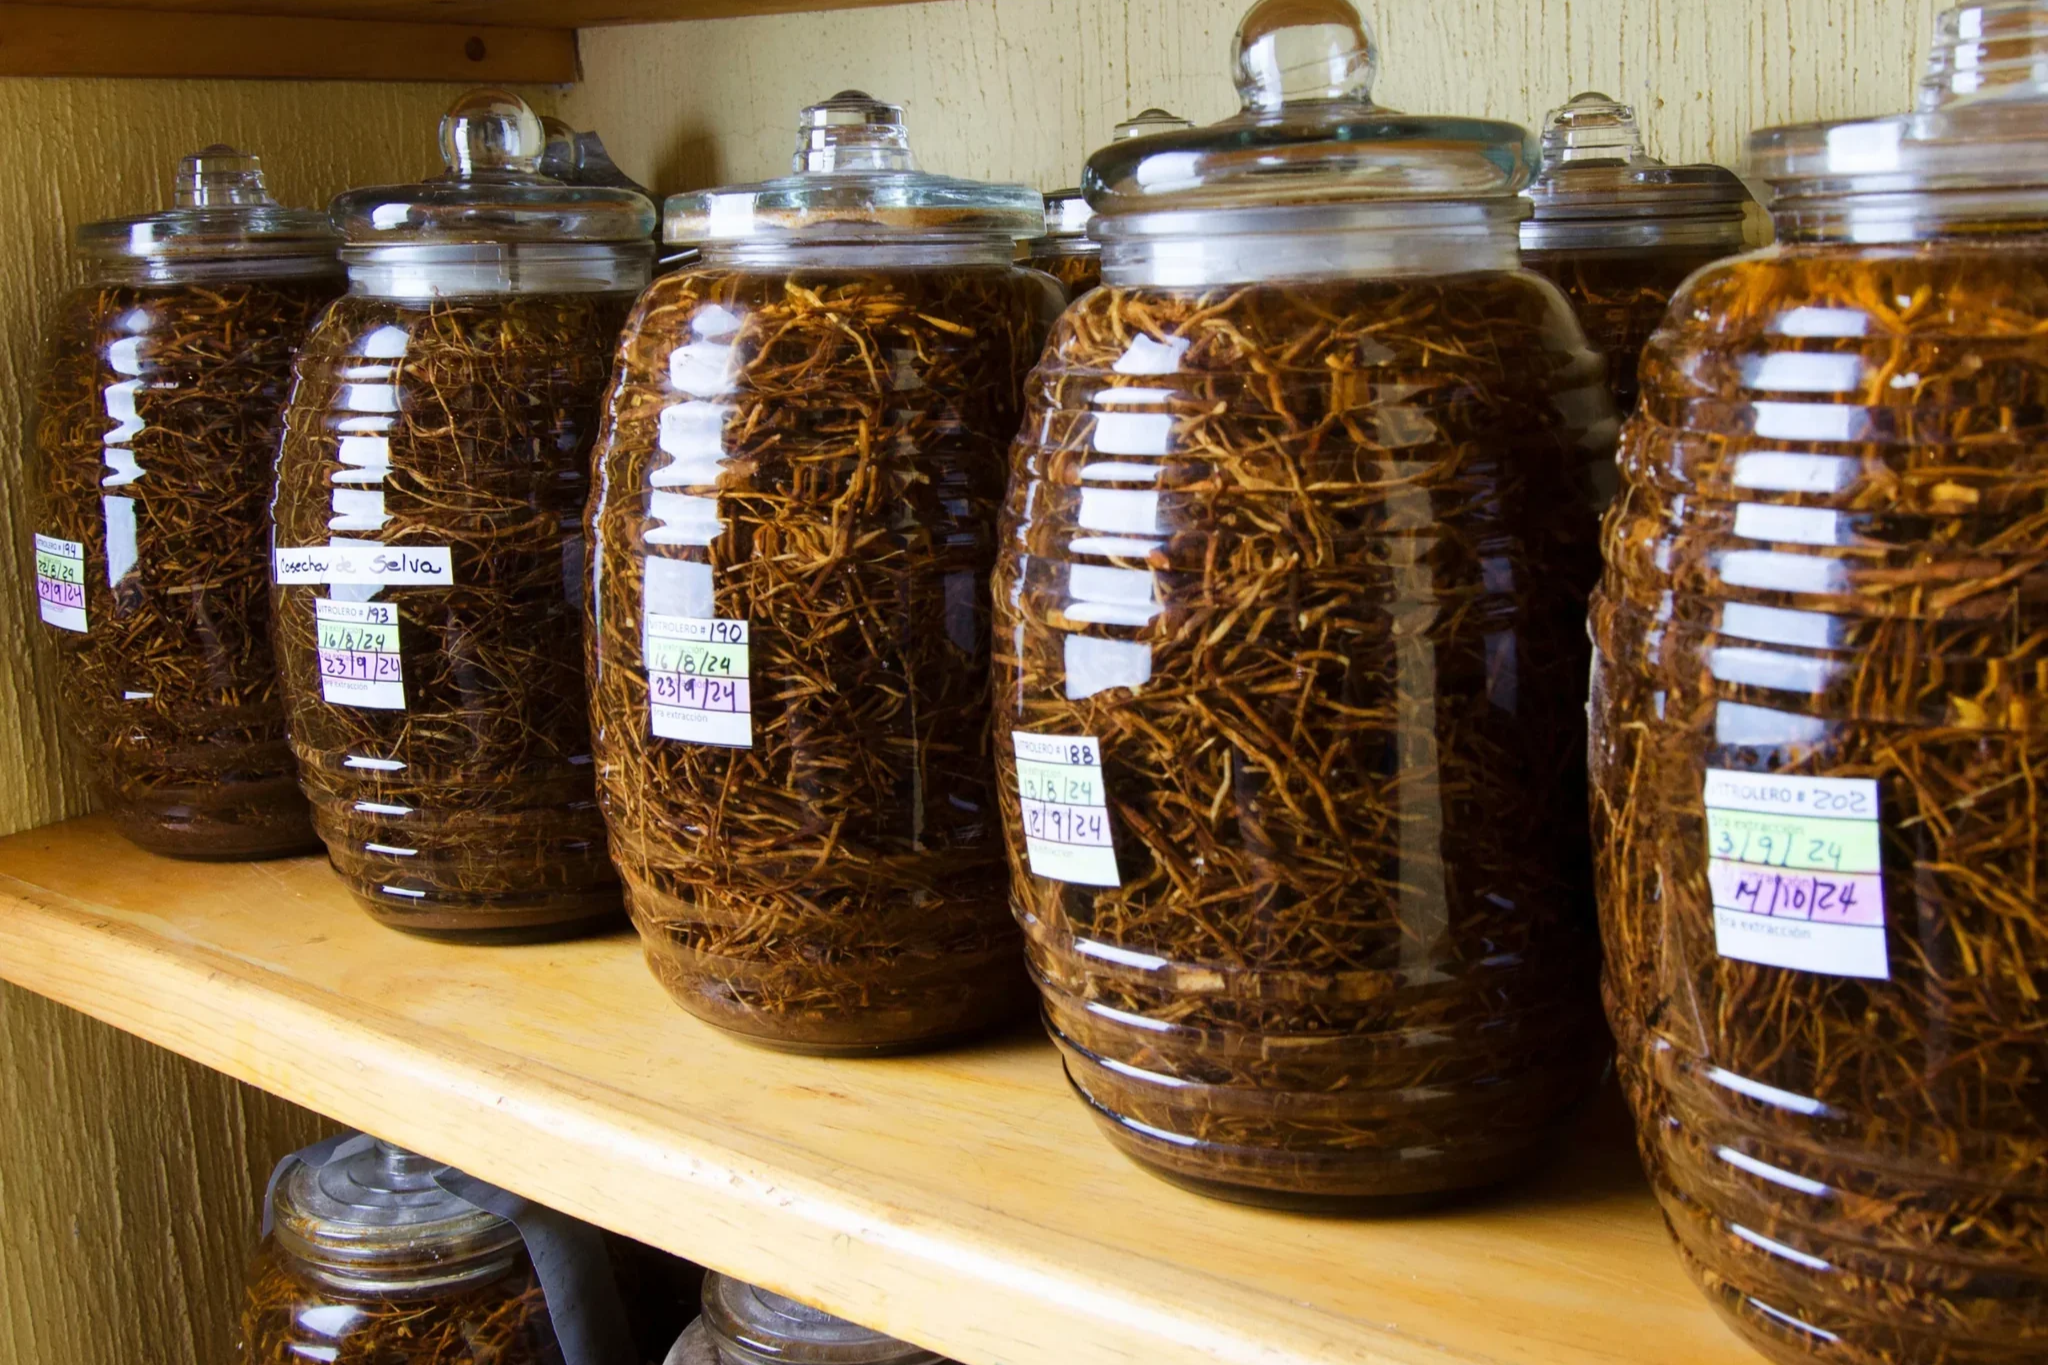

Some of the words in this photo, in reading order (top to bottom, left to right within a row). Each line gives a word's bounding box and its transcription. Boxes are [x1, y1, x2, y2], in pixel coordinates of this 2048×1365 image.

[280, 554, 330, 574] Cosecha
[336, 555, 356, 574] de
[369, 552, 442, 575] Selva
[318, 604, 357, 617] VITROLERO
[366, 605, 389, 624] 193
[650, 619, 697, 635] VITROLERO
[709, 621, 742, 643] 190
[325, 647, 400, 685] 23/9/24
[655, 649, 731, 675] 16/8/24
[656, 671, 736, 713] 23/9/24
[666, 710, 708, 723] extracción
[1064, 744, 1094, 764] 188
[1812, 789, 1868, 814] 202
